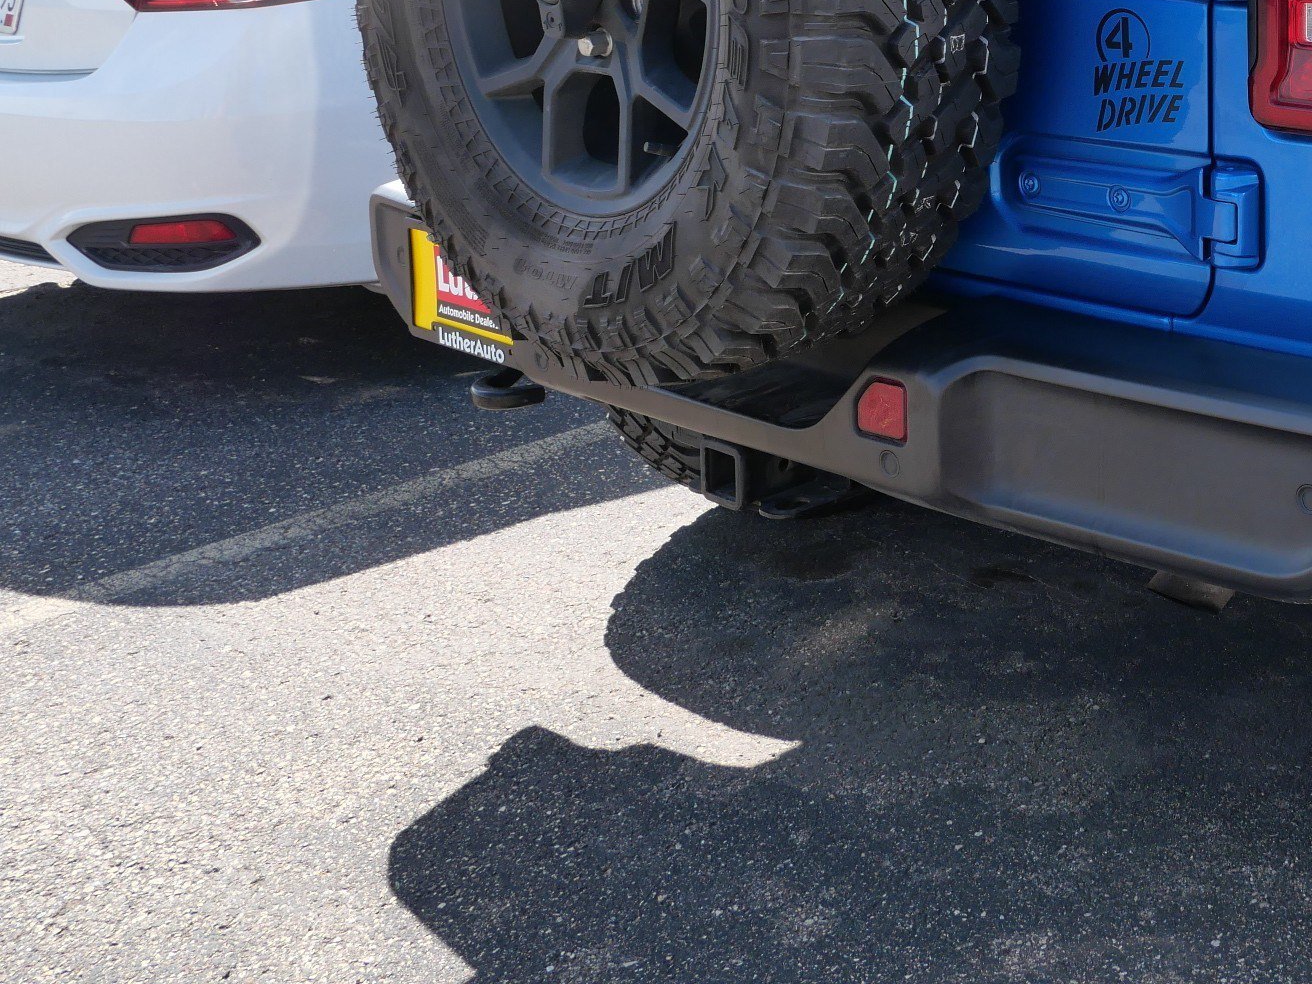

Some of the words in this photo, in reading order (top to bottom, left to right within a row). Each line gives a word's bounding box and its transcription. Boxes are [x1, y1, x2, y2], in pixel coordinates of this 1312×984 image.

[1105, 17, 1133, 58] 4
[1093, 59, 1185, 97] WHEEL
[1096, 94, 1184, 132] DRIVE
[438, 303, 474, 323] Automobile
[438, 326, 505, 364] LutherAuto
